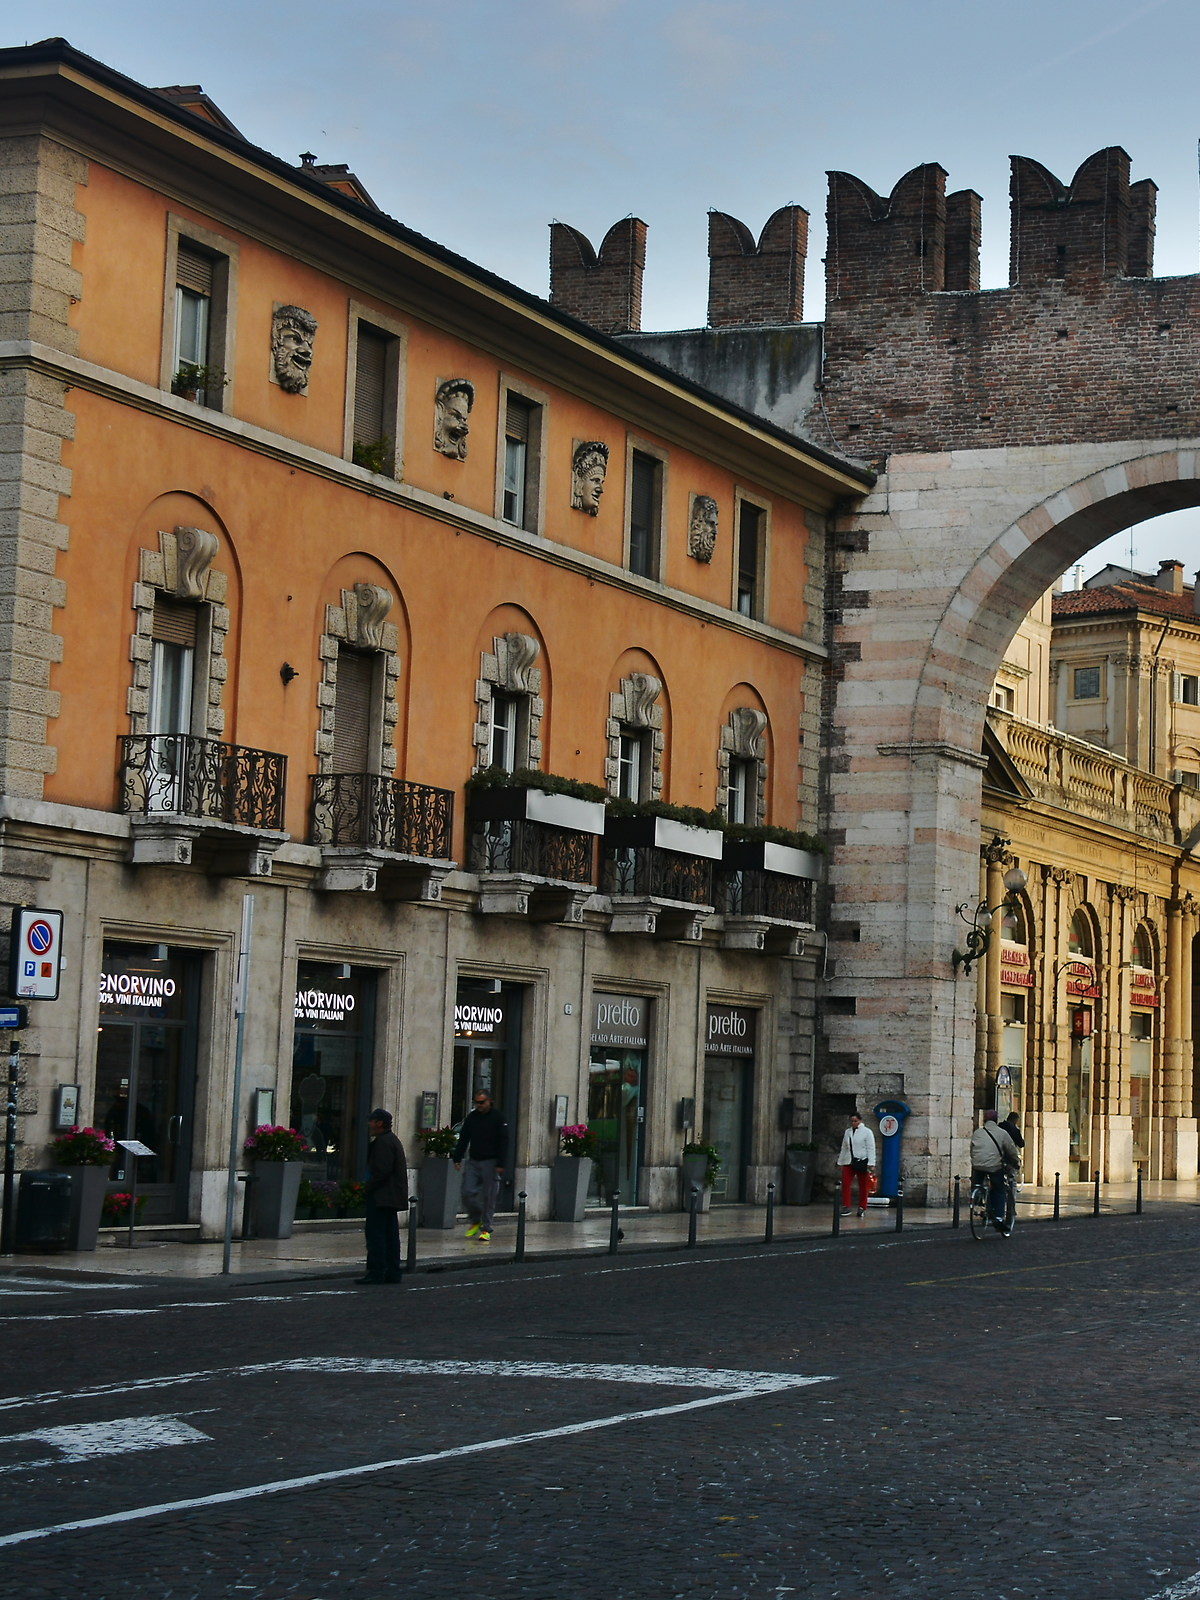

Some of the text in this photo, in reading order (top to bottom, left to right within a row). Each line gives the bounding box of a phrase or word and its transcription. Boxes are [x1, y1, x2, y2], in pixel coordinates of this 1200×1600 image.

[26, 963, 34, 975] P
[115, 993, 132, 1005] VINI
[132, 994, 163, 1007] ITALIANI
[305, 1008, 319, 1019] VINI
[319, 1009, 344, 1021] ITALIANI
[597, 1000, 640, 1030] pretto
[460, 1021, 472, 1031] VINI
[472, 1021, 494, 1032] ITALIANI
[709, 1011, 747, 1040] pretto
[590, 1033, 608, 1043] ELATO
